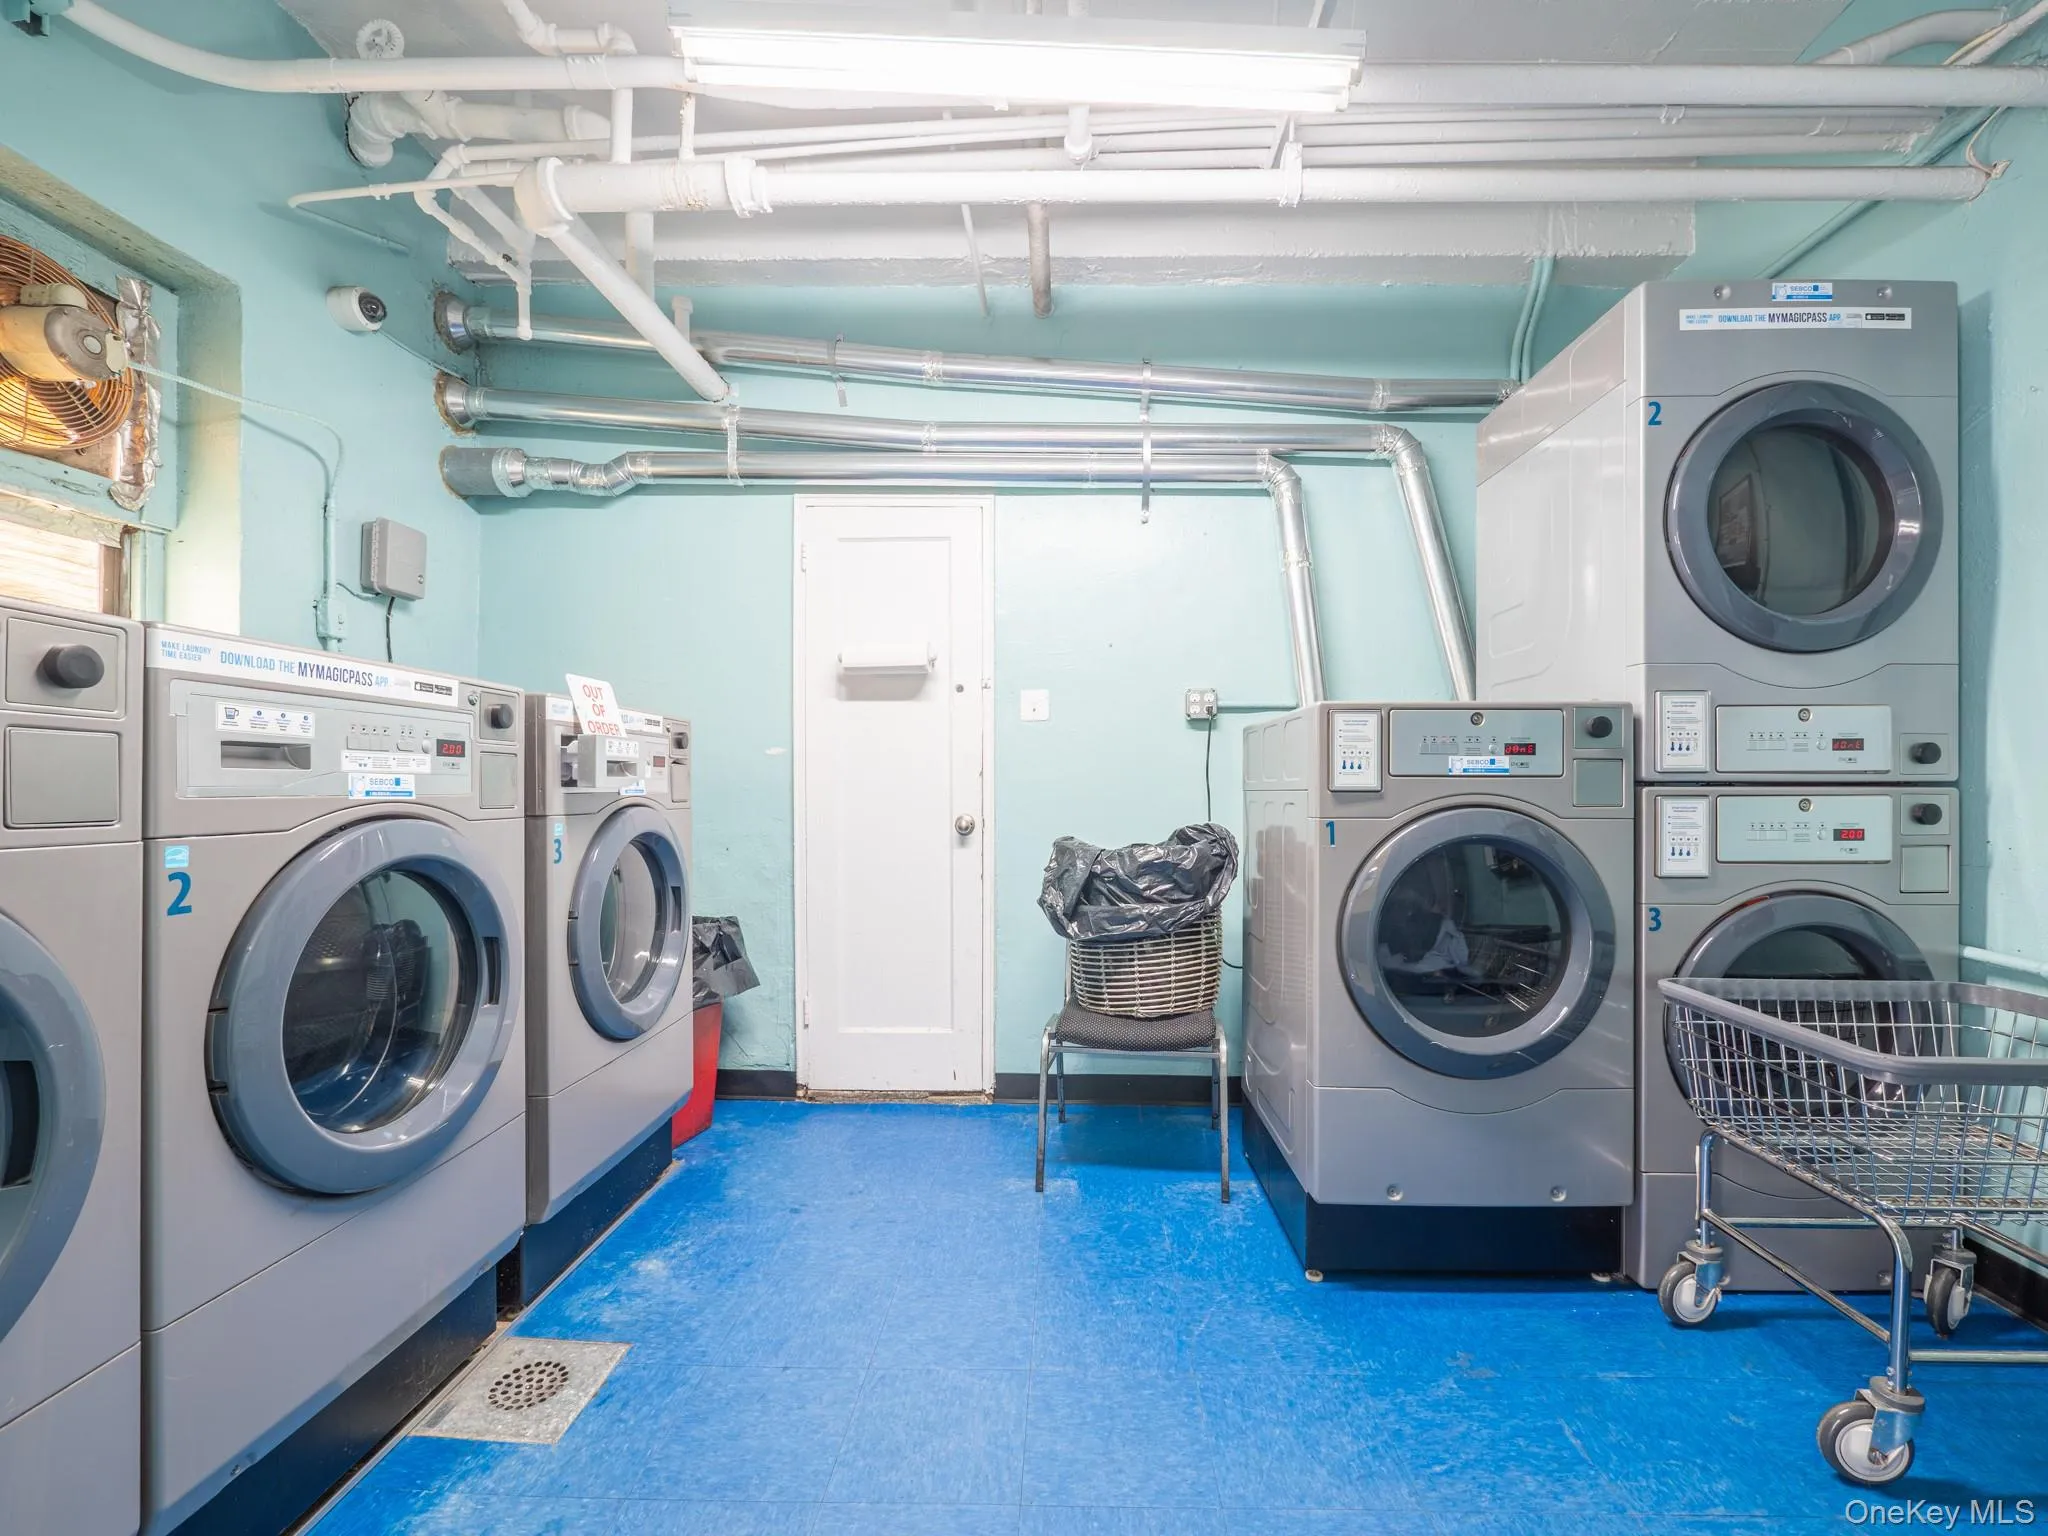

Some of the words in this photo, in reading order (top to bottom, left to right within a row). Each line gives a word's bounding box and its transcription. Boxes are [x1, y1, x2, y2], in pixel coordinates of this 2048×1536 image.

[1718, 314, 1752, 323] DOWNLOAD
[1755, 314, 1766, 322] THE
[1768, 312, 1828, 323] MYMAGICPASS
[1829, 313, 1841, 321] APP
[1648, 401, 1662, 426] 2
[161, 640, 180, 652] MAKE
[182, 643, 212, 655] LAUNDRY
[161, 649, 177, 660] TIME
[179, 652, 202, 662] EASIER
[220, 651, 276, 671] DOWNLOAD
[278, 660, 296, 674] THE
[298, 661, 374, 687] MYMAGICPASS
[582, 684, 603, 700] OUT
[592, 703, 606, 717] OF
[587, 720, 622, 737] ORDER
[369, 777, 394, 786] SEBCO
[1325, 820, 1336, 846] 1
[553, 838, 562, 865] 3
[167, 871, 193, 917] 2
[1648, 906, 1662, 932] 3
